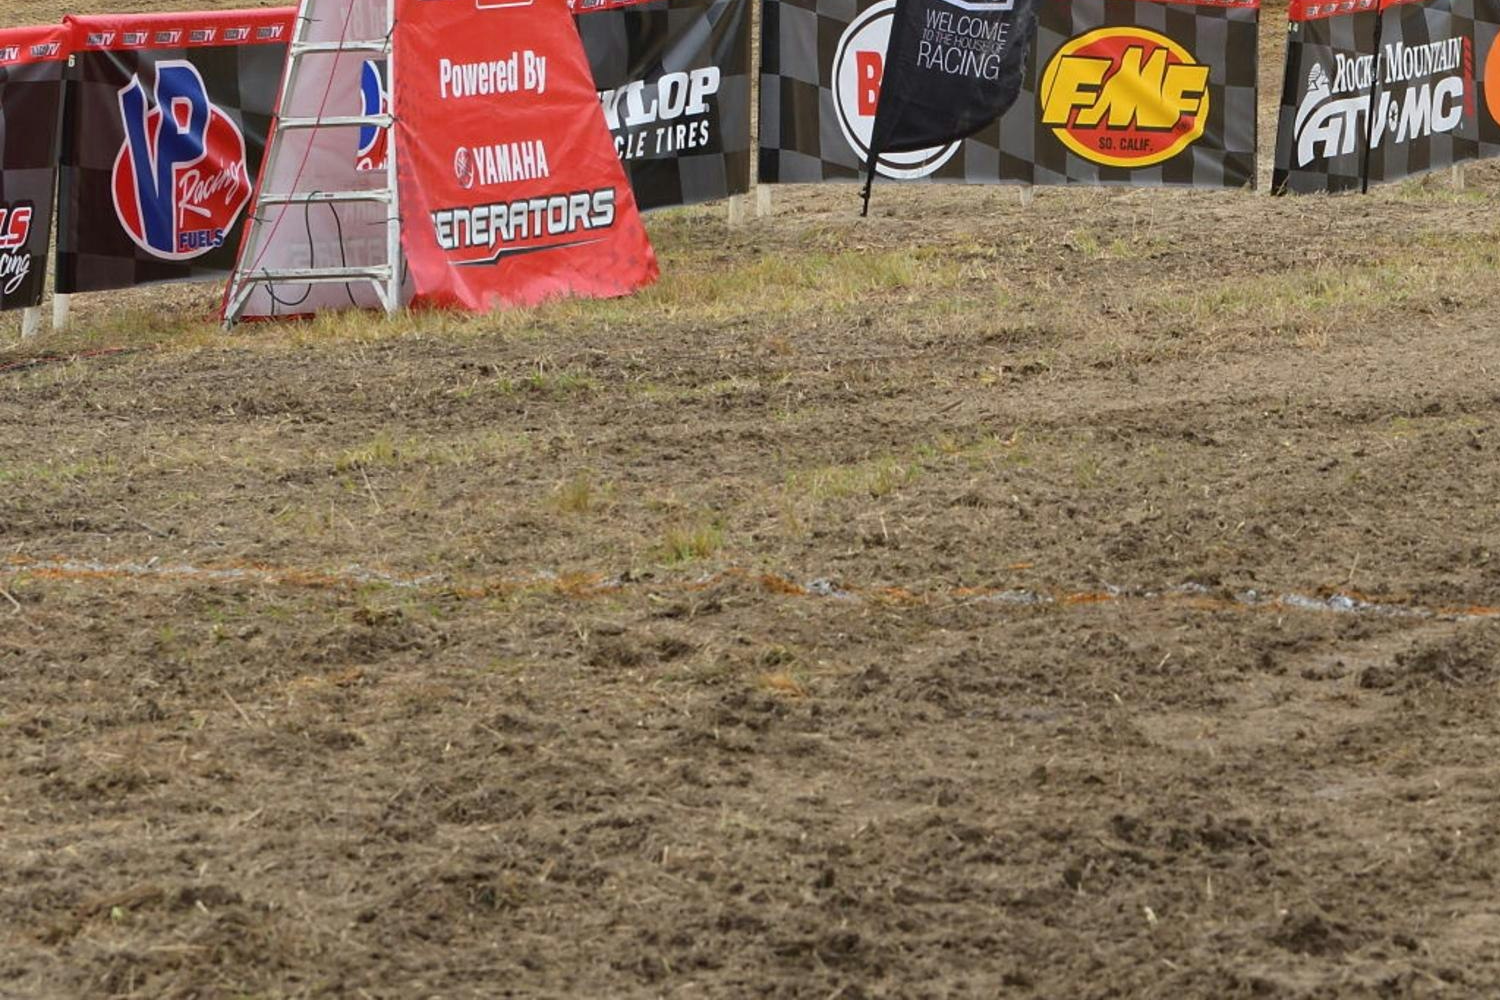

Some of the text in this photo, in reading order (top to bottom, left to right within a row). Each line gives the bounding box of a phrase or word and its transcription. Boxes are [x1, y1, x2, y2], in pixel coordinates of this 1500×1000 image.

[926, 8, 1011, 43] WELCOME
[439, 49, 547, 98] Powered By
[916, 41, 1001, 80] RACING
[1385, 37, 1464, 83] MOUNTAIN
[595, 65, 721, 130] NLOP
[1043, 46, 1211, 131] FMF
[118, 60, 209, 255] VP
[655, 120, 710, 153] TIRES
[1120, 138, 1154, 152] CALIF.
[472, 139, 550, 185] YAMAHA
[178, 160, 243, 228] Racing
[178, 230, 225, 250] FUELS
[432, 187, 616, 250] ENERATORS
